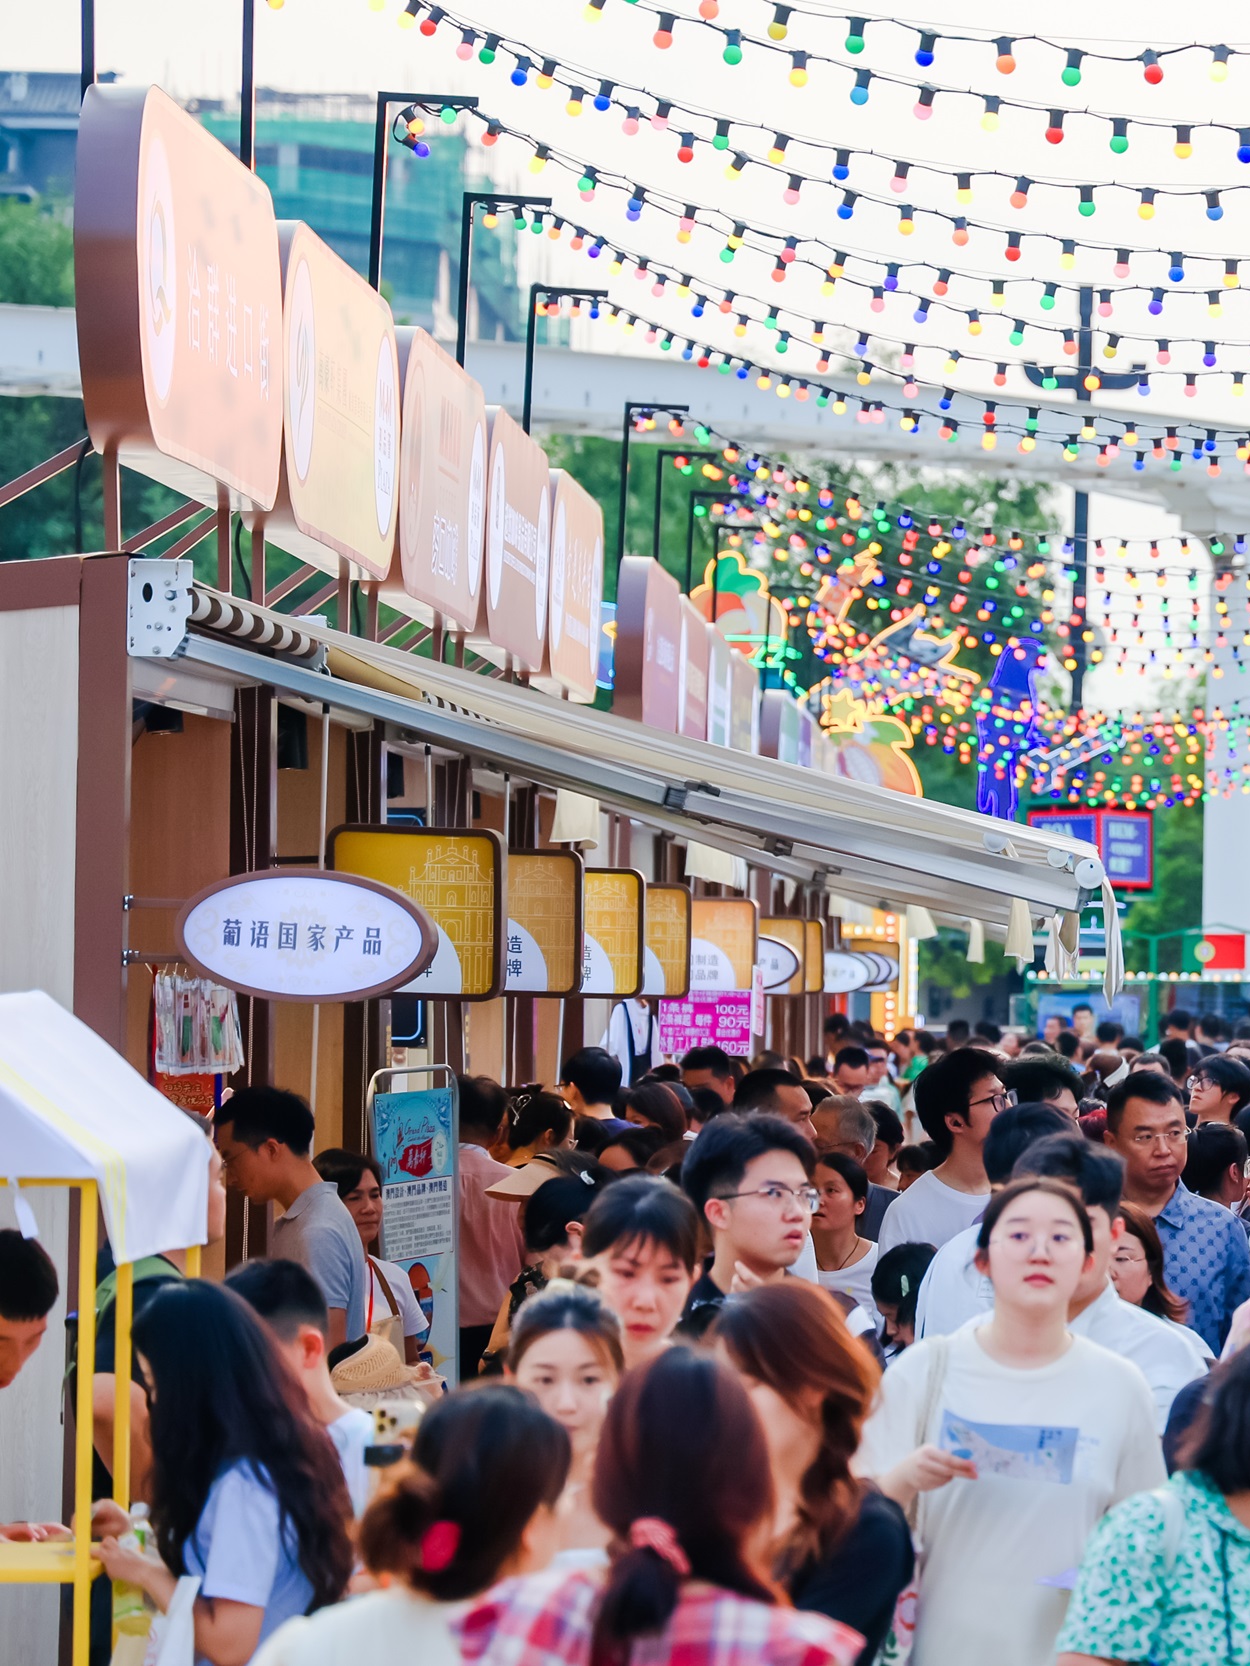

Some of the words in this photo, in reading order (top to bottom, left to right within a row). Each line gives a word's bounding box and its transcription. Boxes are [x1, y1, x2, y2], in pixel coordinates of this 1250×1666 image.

[223, 918, 382, 956] 葡语国家产品
[715, 1004, 749, 1015] 100元
[718, 1016, 749, 1029] 90元
